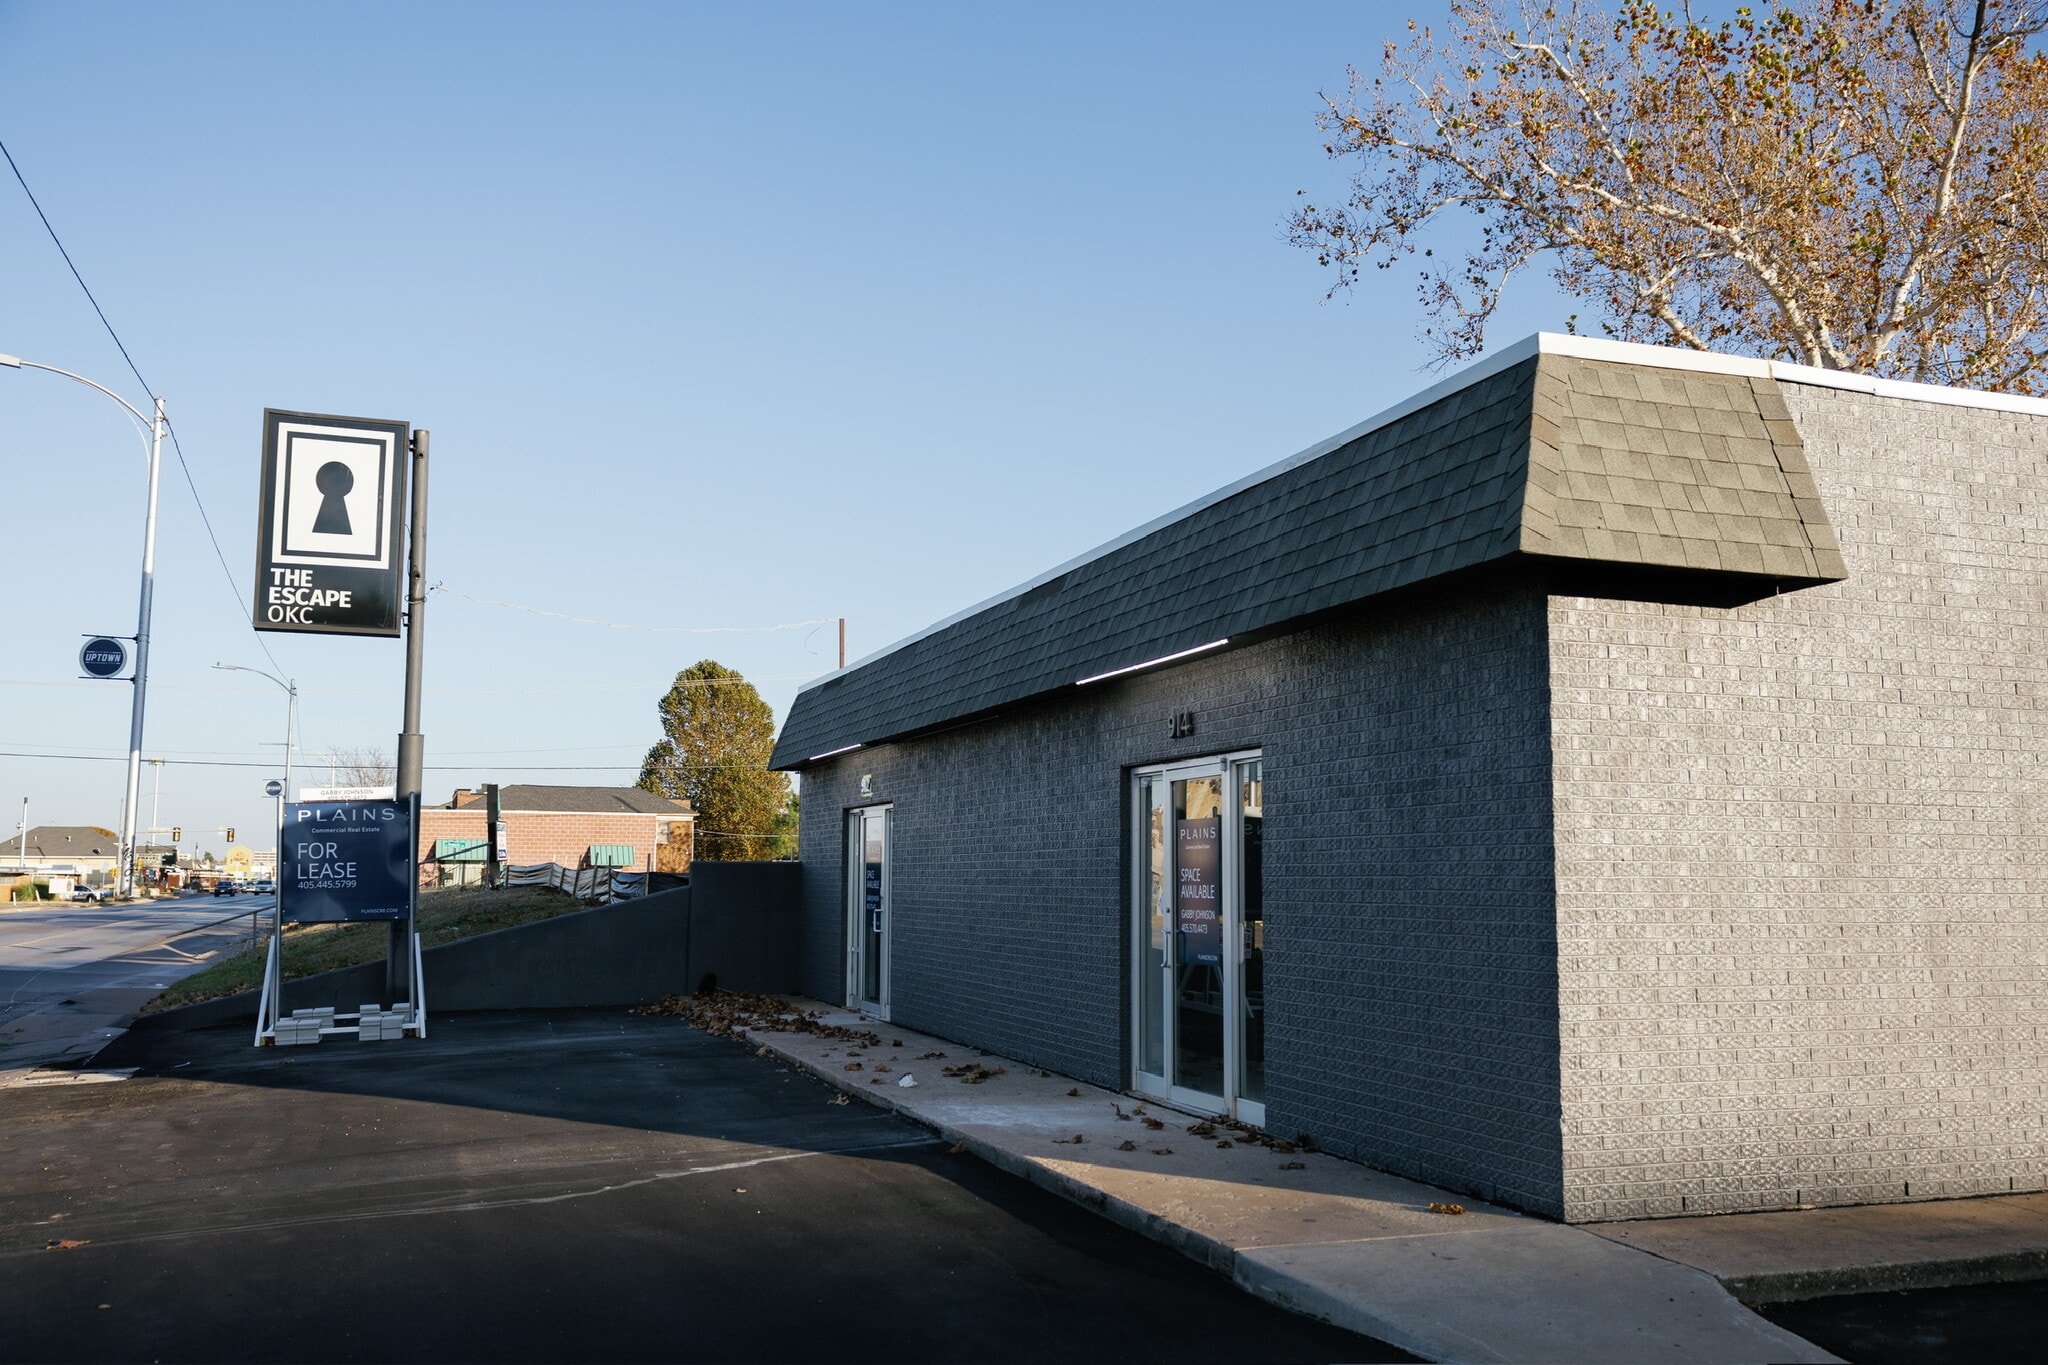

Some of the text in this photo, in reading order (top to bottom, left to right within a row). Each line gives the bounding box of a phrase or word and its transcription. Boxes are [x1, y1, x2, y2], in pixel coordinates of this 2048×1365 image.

[270, 567, 313, 588] THE
[268, 586, 352, 608] ESCAPE
[267, 605, 314, 624] OKC
[85, 653, 121, 662] UPTOWN
[1167, 709, 1189, 738] 914
[343, 788, 374, 796] JOHNSON
[298, 808, 395, 822] PLAINS
[1180, 826, 1216, 840] PLAINS
[297, 842, 338, 860] FOR
[297, 862, 357, 879] LEASE
[1180, 867, 1201, 882] SPACE
[297, 880, 357, 889] 405.445.5799
[1180, 884, 1215, 899] AVAILABLE
[1181, 909, 1216, 921] GABBY JOHNSON
